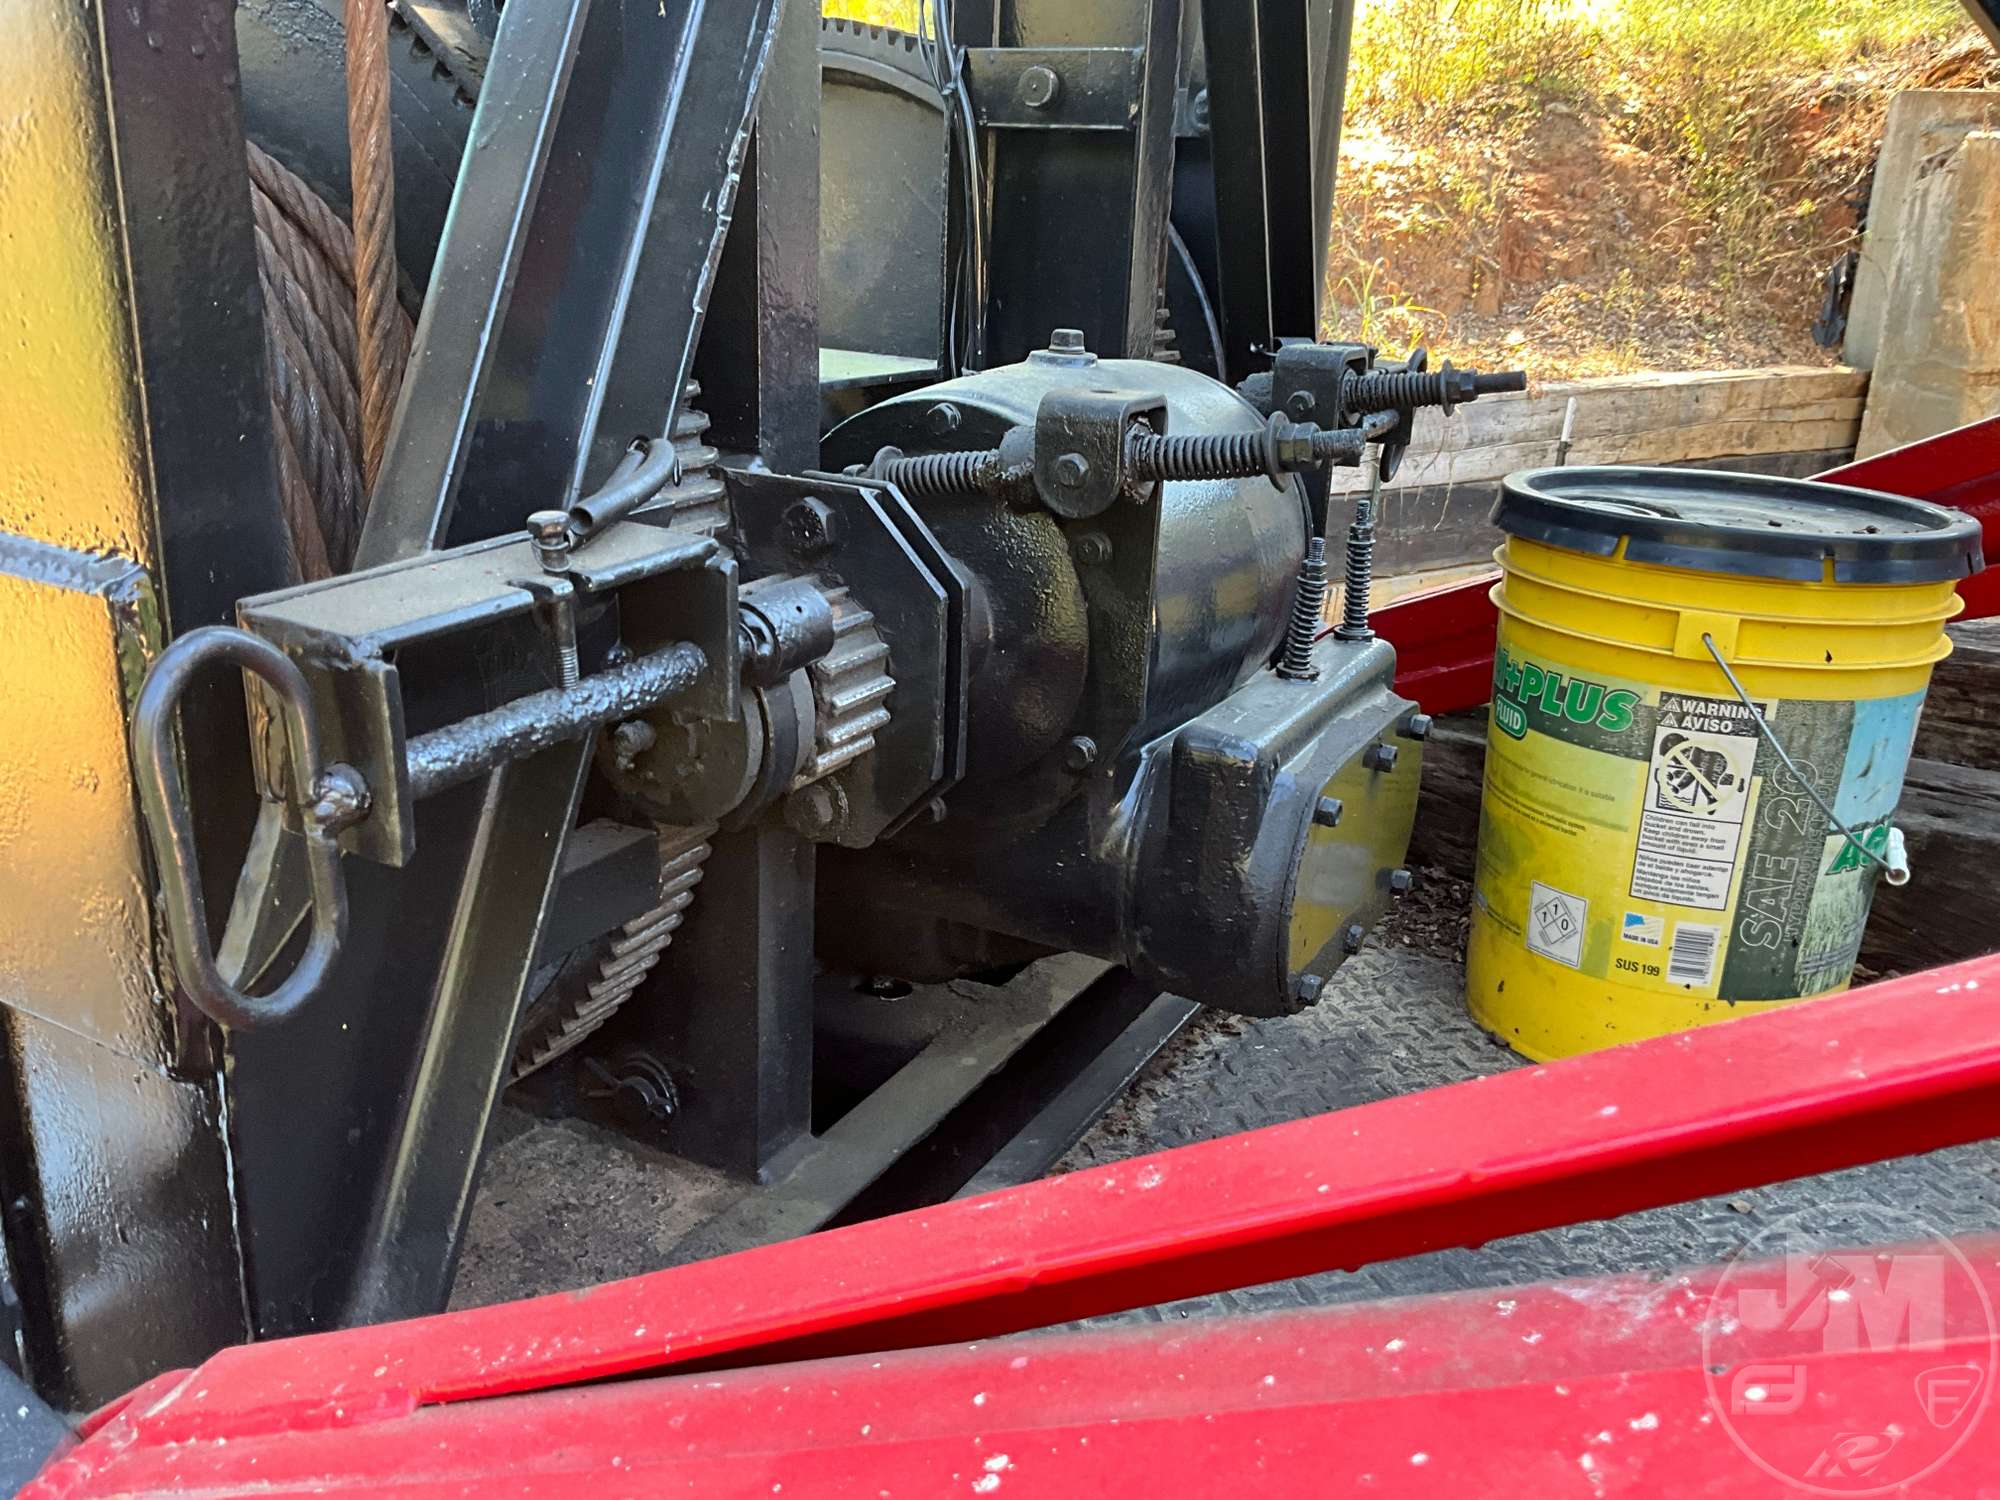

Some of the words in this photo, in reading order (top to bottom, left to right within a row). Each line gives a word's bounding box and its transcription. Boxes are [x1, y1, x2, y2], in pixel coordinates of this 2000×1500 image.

[1681, 699, 1763, 722] WARNING
[1681, 716, 1733, 733] AVISO
[1764, 759, 1818, 836] 20
[1644, 820, 1666, 829] bucket
[1645, 814, 1674, 824] Children
[1643, 827, 1660, 835] Keep
[1662, 830, 1689, 839] children
[1740, 852, 1799, 950] SAE
[1553, 903, 1559, 916] 1
[1541, 911, 1548, 923] 1
[1561, 918, 1569, 931] 0
[1623, 932, 1639, 941] MADE
[1615, 958, 1640, 973] SUS
[1642, 963, 1661, 977] 199
